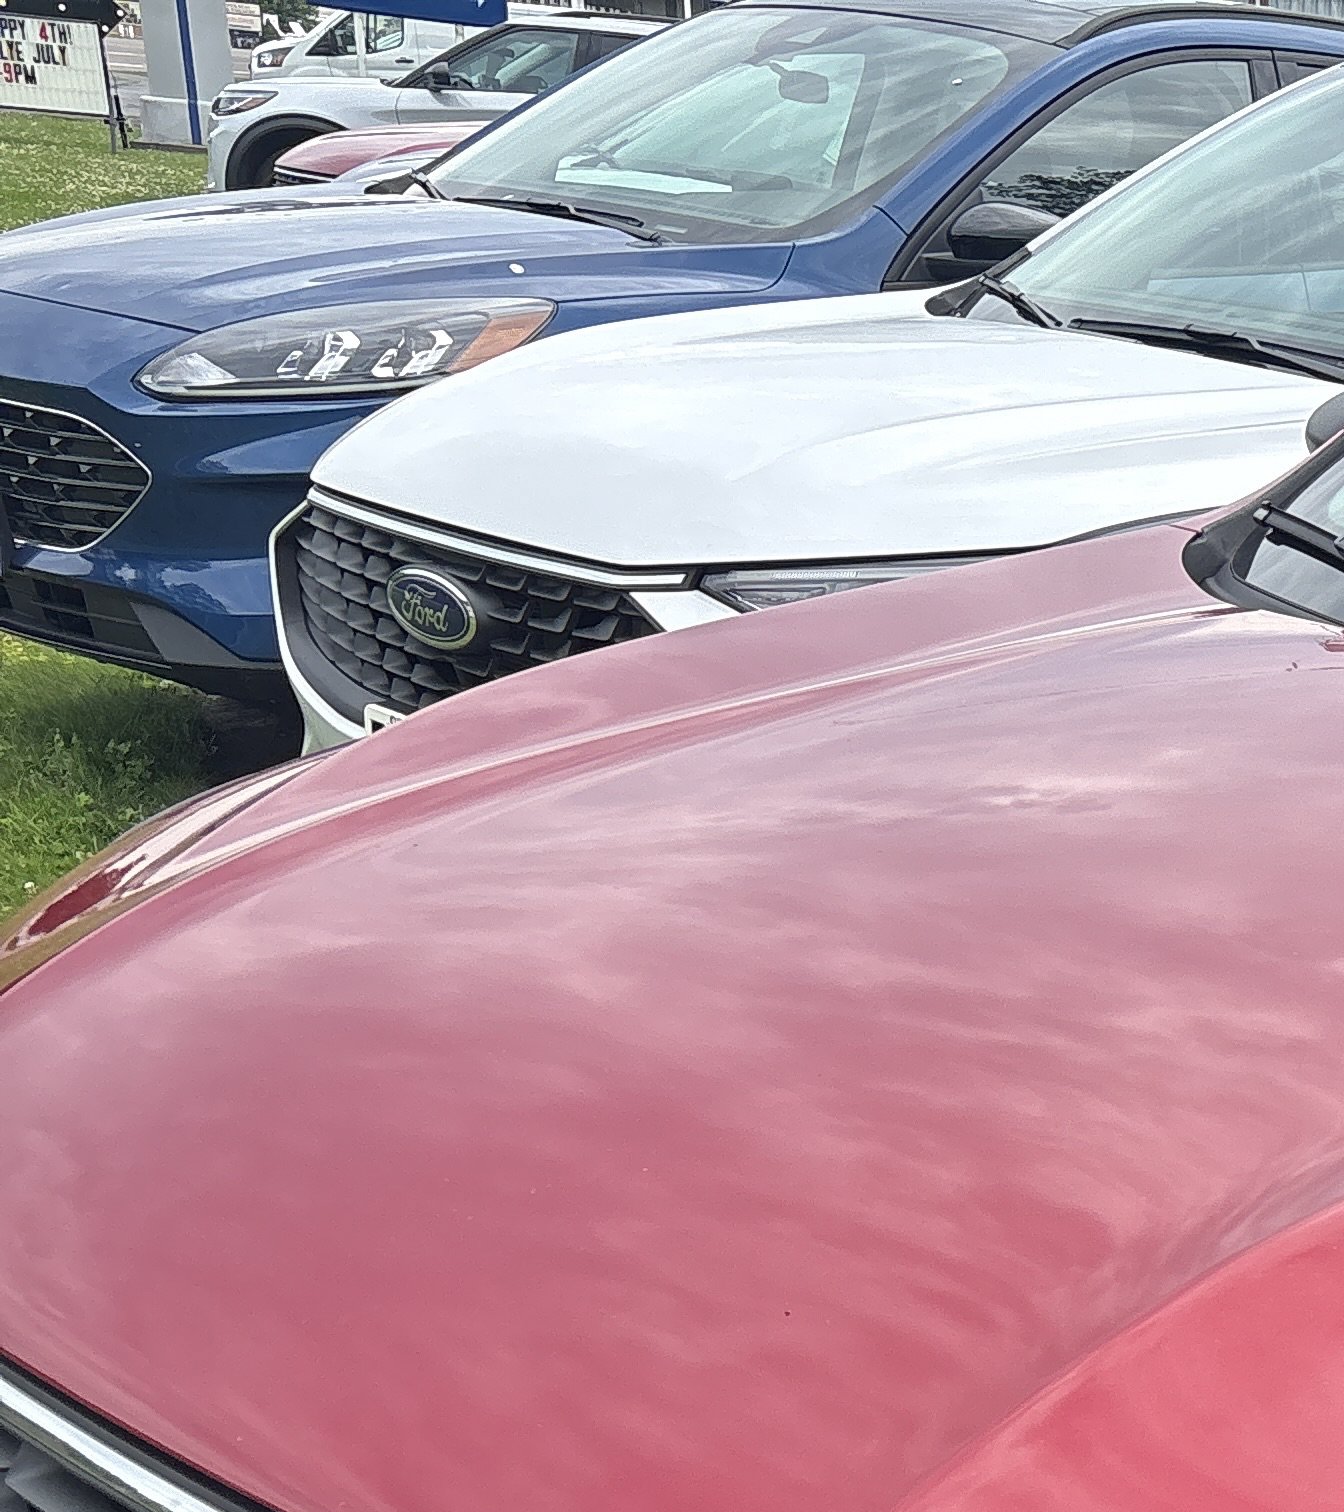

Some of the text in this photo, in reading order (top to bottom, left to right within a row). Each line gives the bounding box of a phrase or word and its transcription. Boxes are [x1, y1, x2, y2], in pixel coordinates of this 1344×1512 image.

[39, 22, 73, 45] 4TH!
[33, 43, 67, 66] JULY
[402, 584, 448, 632] Ford
